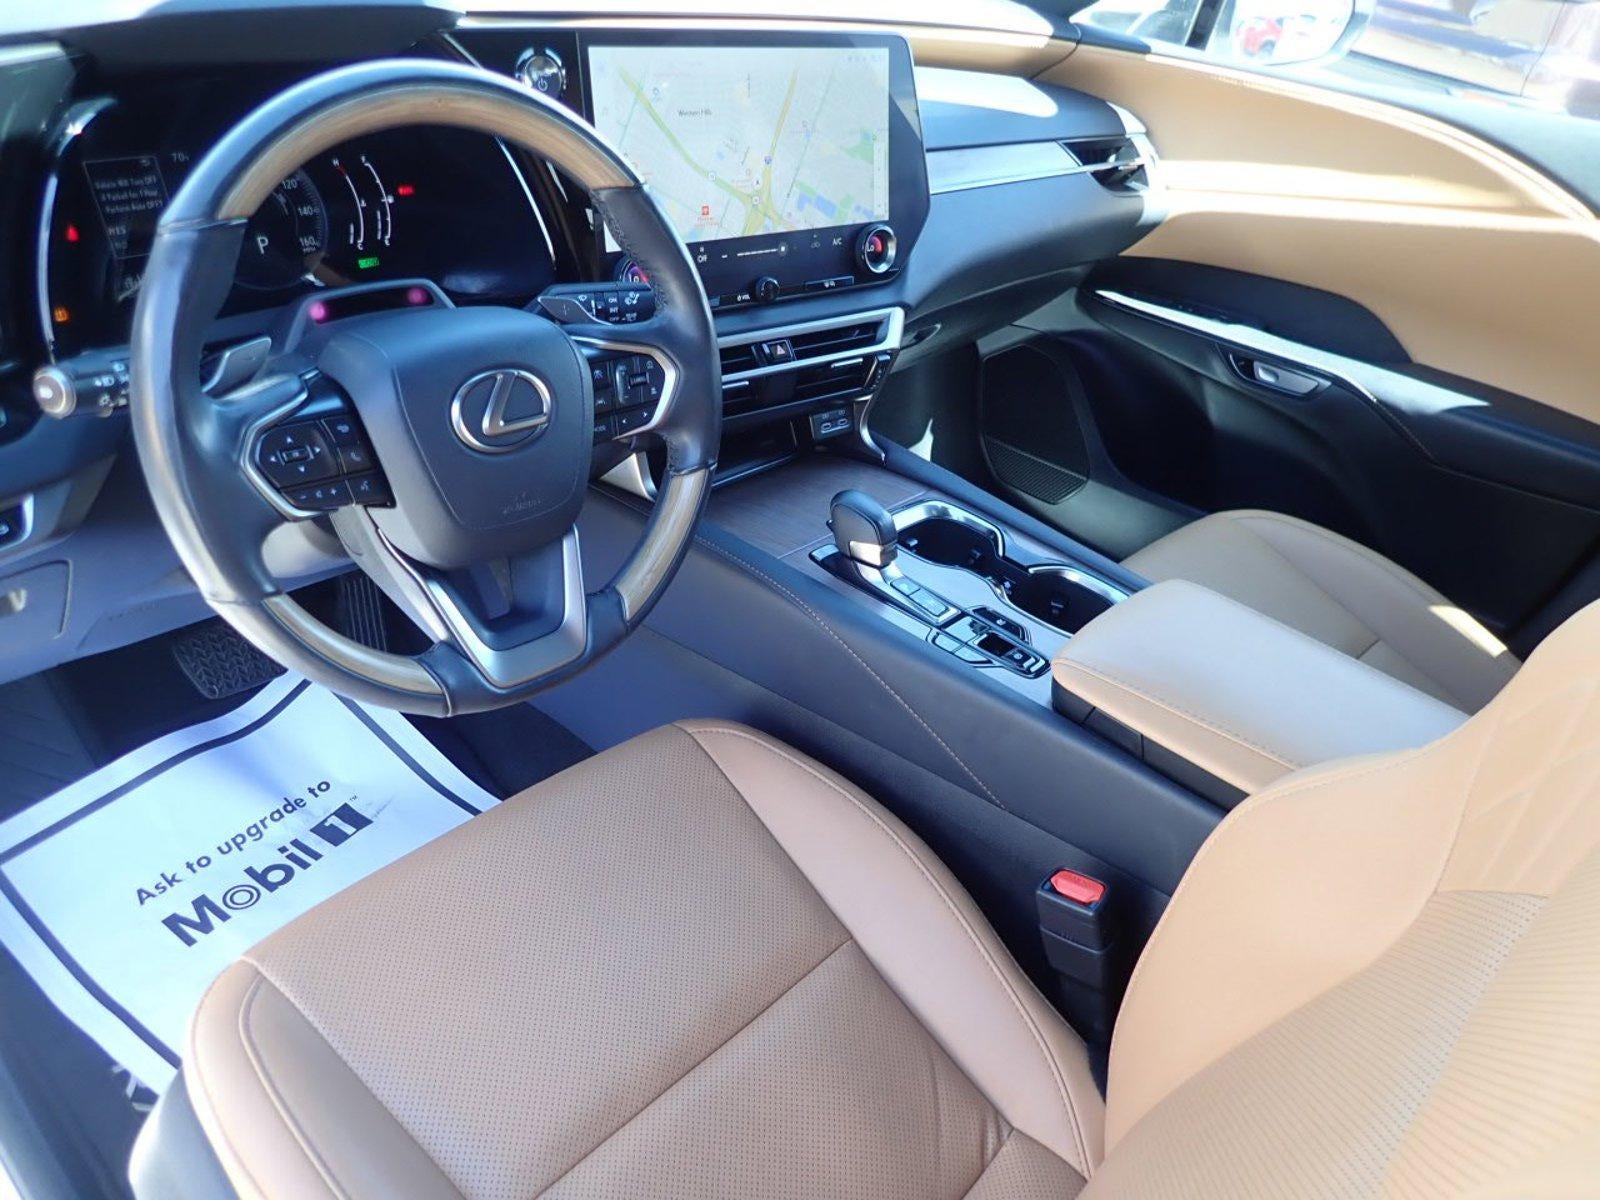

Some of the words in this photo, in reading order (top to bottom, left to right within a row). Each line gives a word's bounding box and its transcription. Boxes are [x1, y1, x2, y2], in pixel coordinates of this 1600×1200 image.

[282, 178, 298, 190] 120
[298, 206, 314, 217] 140
[257, 236, 269, 255] P
[299, 235, 316, 248] 160
[136, 872, 183, 906] Ask
[185, 855, 212, 874] to
[217, 797, 307, 856] upgrade
[308, 780, 331, 799] to
[161, 838, 324, 948] Mobil
